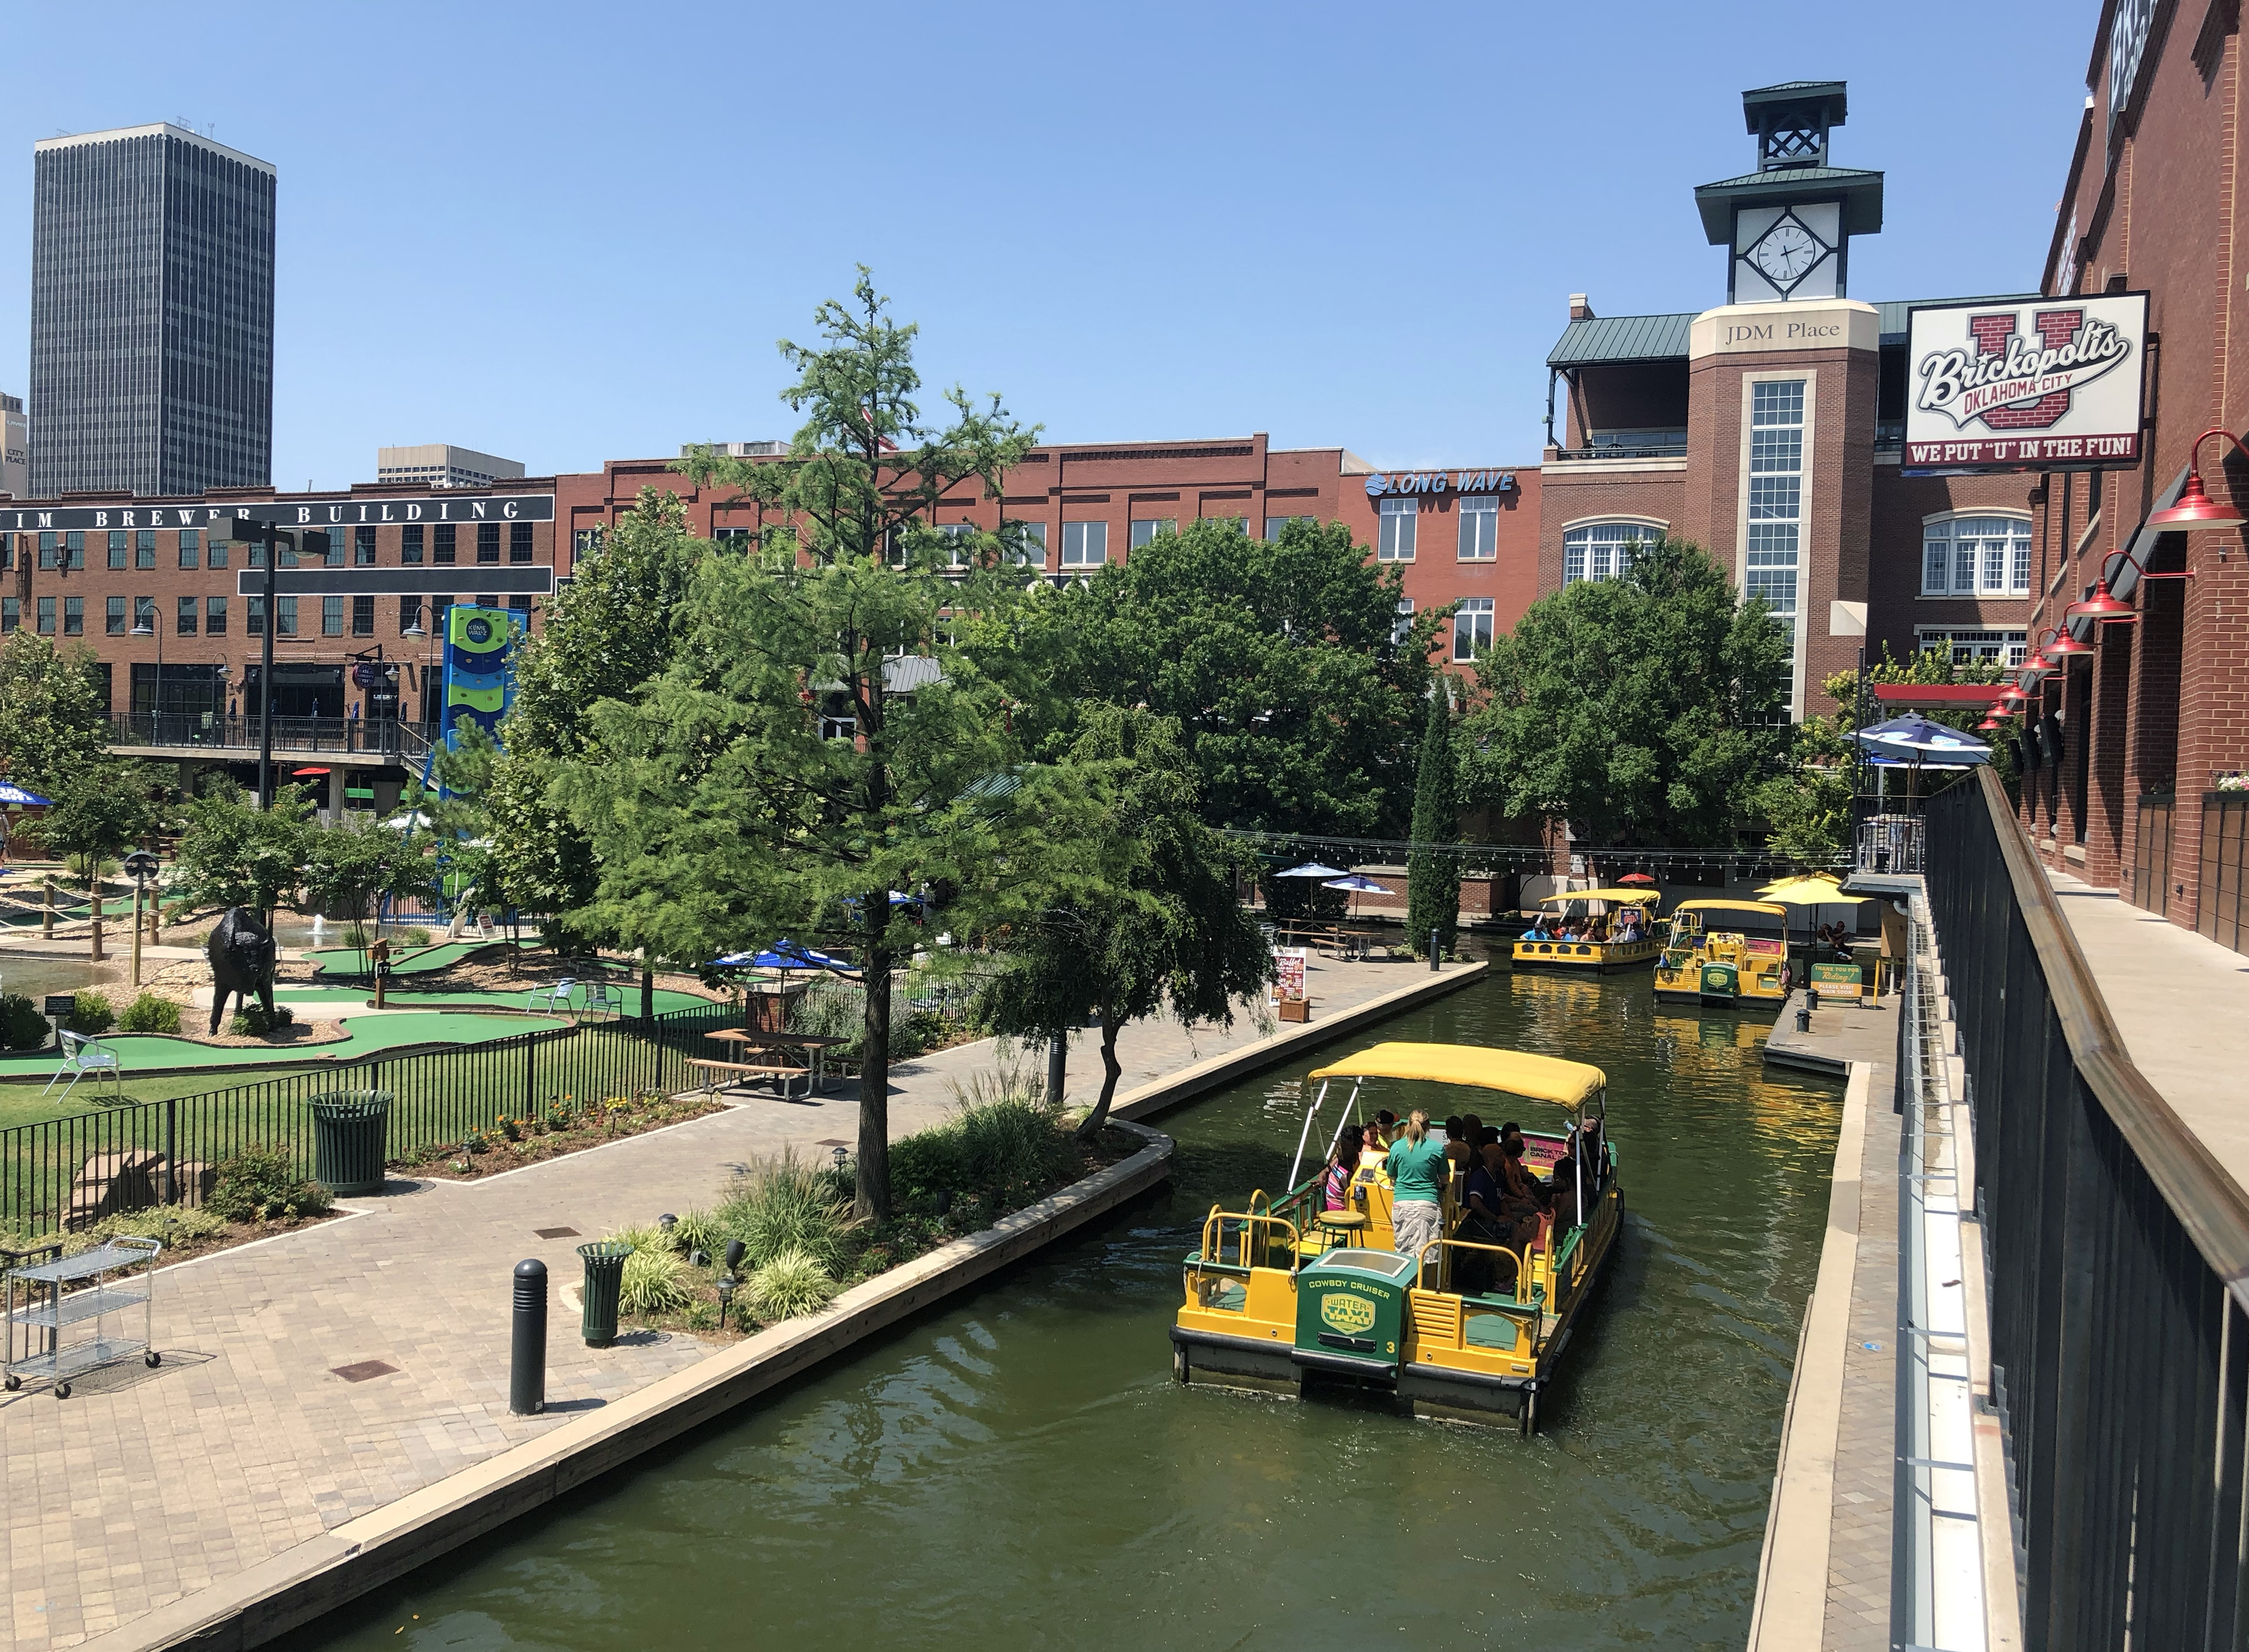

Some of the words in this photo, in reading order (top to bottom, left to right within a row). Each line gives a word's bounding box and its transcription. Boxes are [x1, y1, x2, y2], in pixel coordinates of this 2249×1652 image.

[1725, 323, 1774, 345] JDM
[1787, 322, 1840, 338] Place
[1919, 321, 2128, 408] Brickopolis
[1964, 380, 2037, 415] OKLAHOMA
[2042, 374, 2073, 391] CITY
[7, 448, 24, 457] CITY
[1911, 444, 1941, 462] WE
[1944, 442, 1982, 461] PUT
[2018, 441, 2039, 458] IN
[2046, 439, 2082, 457] THE
[2086, 437, 2132, 456] FUN!
[6, 456, 26, 465] PLACE
[1386, 473, 1448, 494] LONG
[1457, 470, 1516, 492] WAVE
[0, 512, 52, 528] IM
[297, 502, 518, 523] BUILDING
[1822, 971, 1855, 983] Riding!
[1309, 1280, 1347, 1289] COWBOY
[1350, 1281, 1391, 1300] CRUISER
[1331, 1298, 1367, 1310] WATER
[1327, 1305, 1370, 1325] TAXI
[1386, 1341, 1395, 1354] 3
